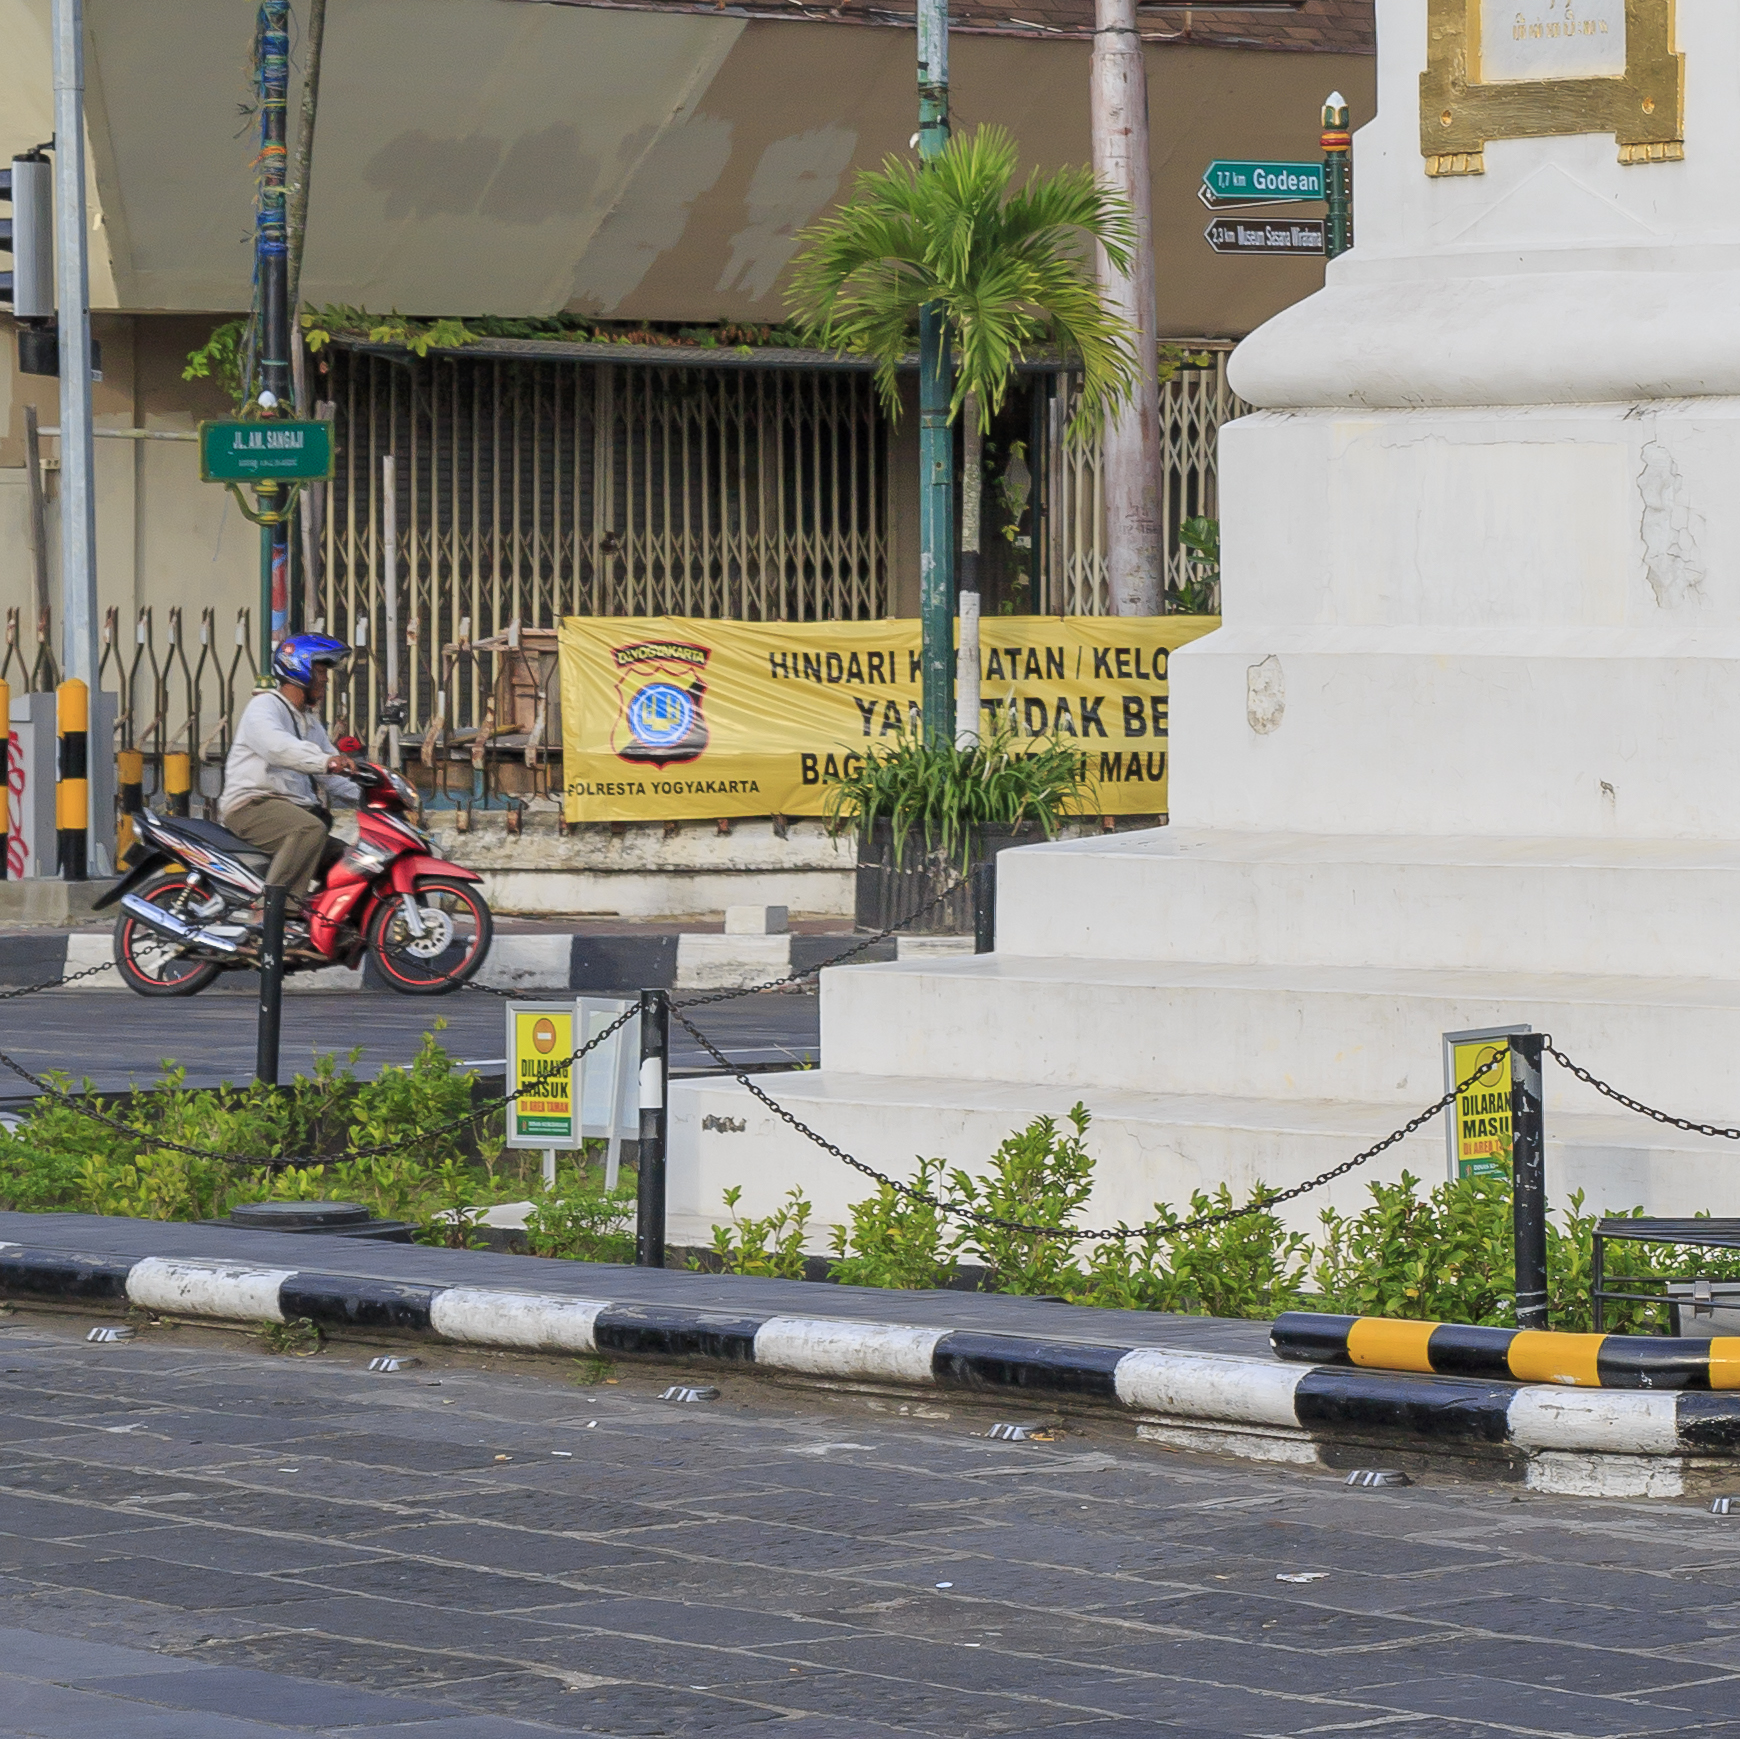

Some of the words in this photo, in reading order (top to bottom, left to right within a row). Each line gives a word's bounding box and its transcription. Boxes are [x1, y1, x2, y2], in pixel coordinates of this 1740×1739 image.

[1233, 172, 1247, 186] km
[1253, 169, 1318, 191] Godean
[769, 650, 896, 684] HINDARI
[979, 695, 1108, 738] TIDAK
[568, 782, 646, 796] POLRESTA
[652, 780, 760, 795] YOGYAKARTA
